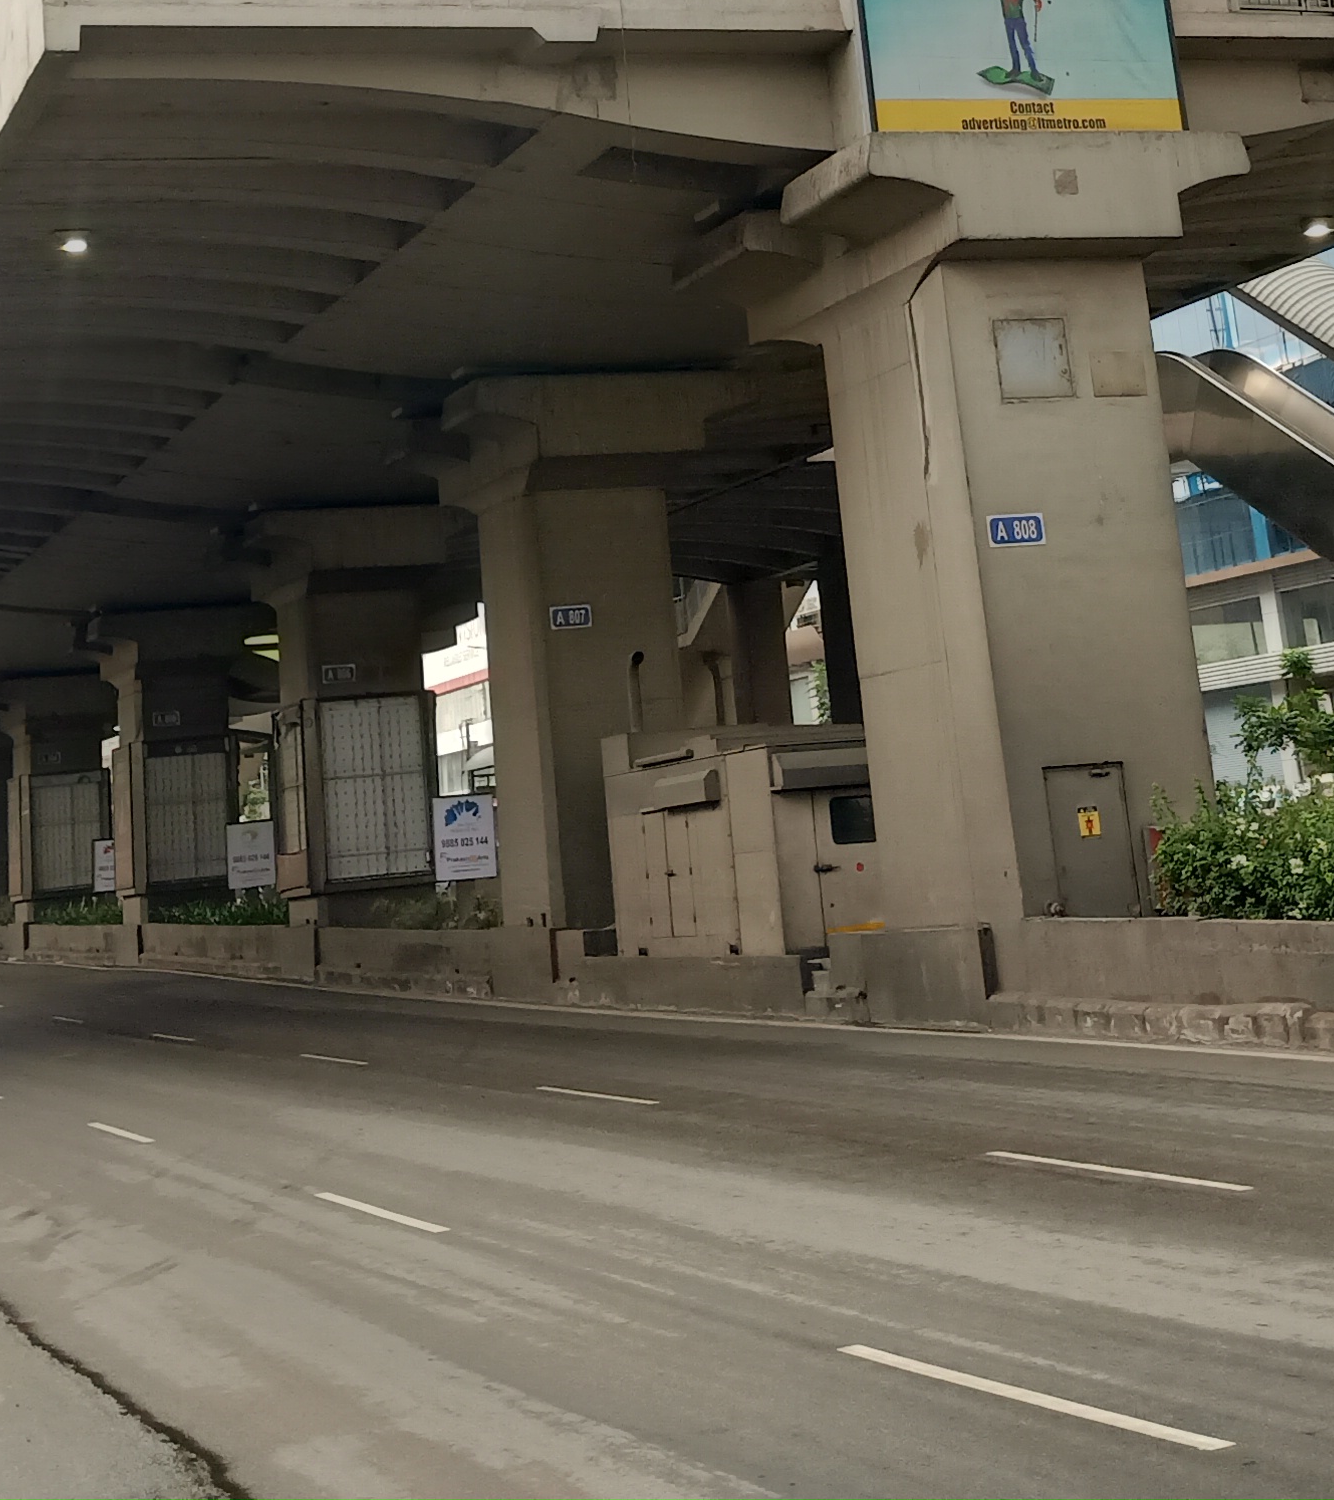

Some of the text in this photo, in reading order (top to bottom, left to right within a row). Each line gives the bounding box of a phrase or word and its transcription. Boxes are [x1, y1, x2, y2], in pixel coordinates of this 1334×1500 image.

[1009, 101, 1055, 114] Contact
[961, 116, 1107, 131] advertising@ltmetro.com
[997, 519, 1037, 540] A 808
[556, 609, 586, 625] A 807
[475, 836, 489, 845] 144
